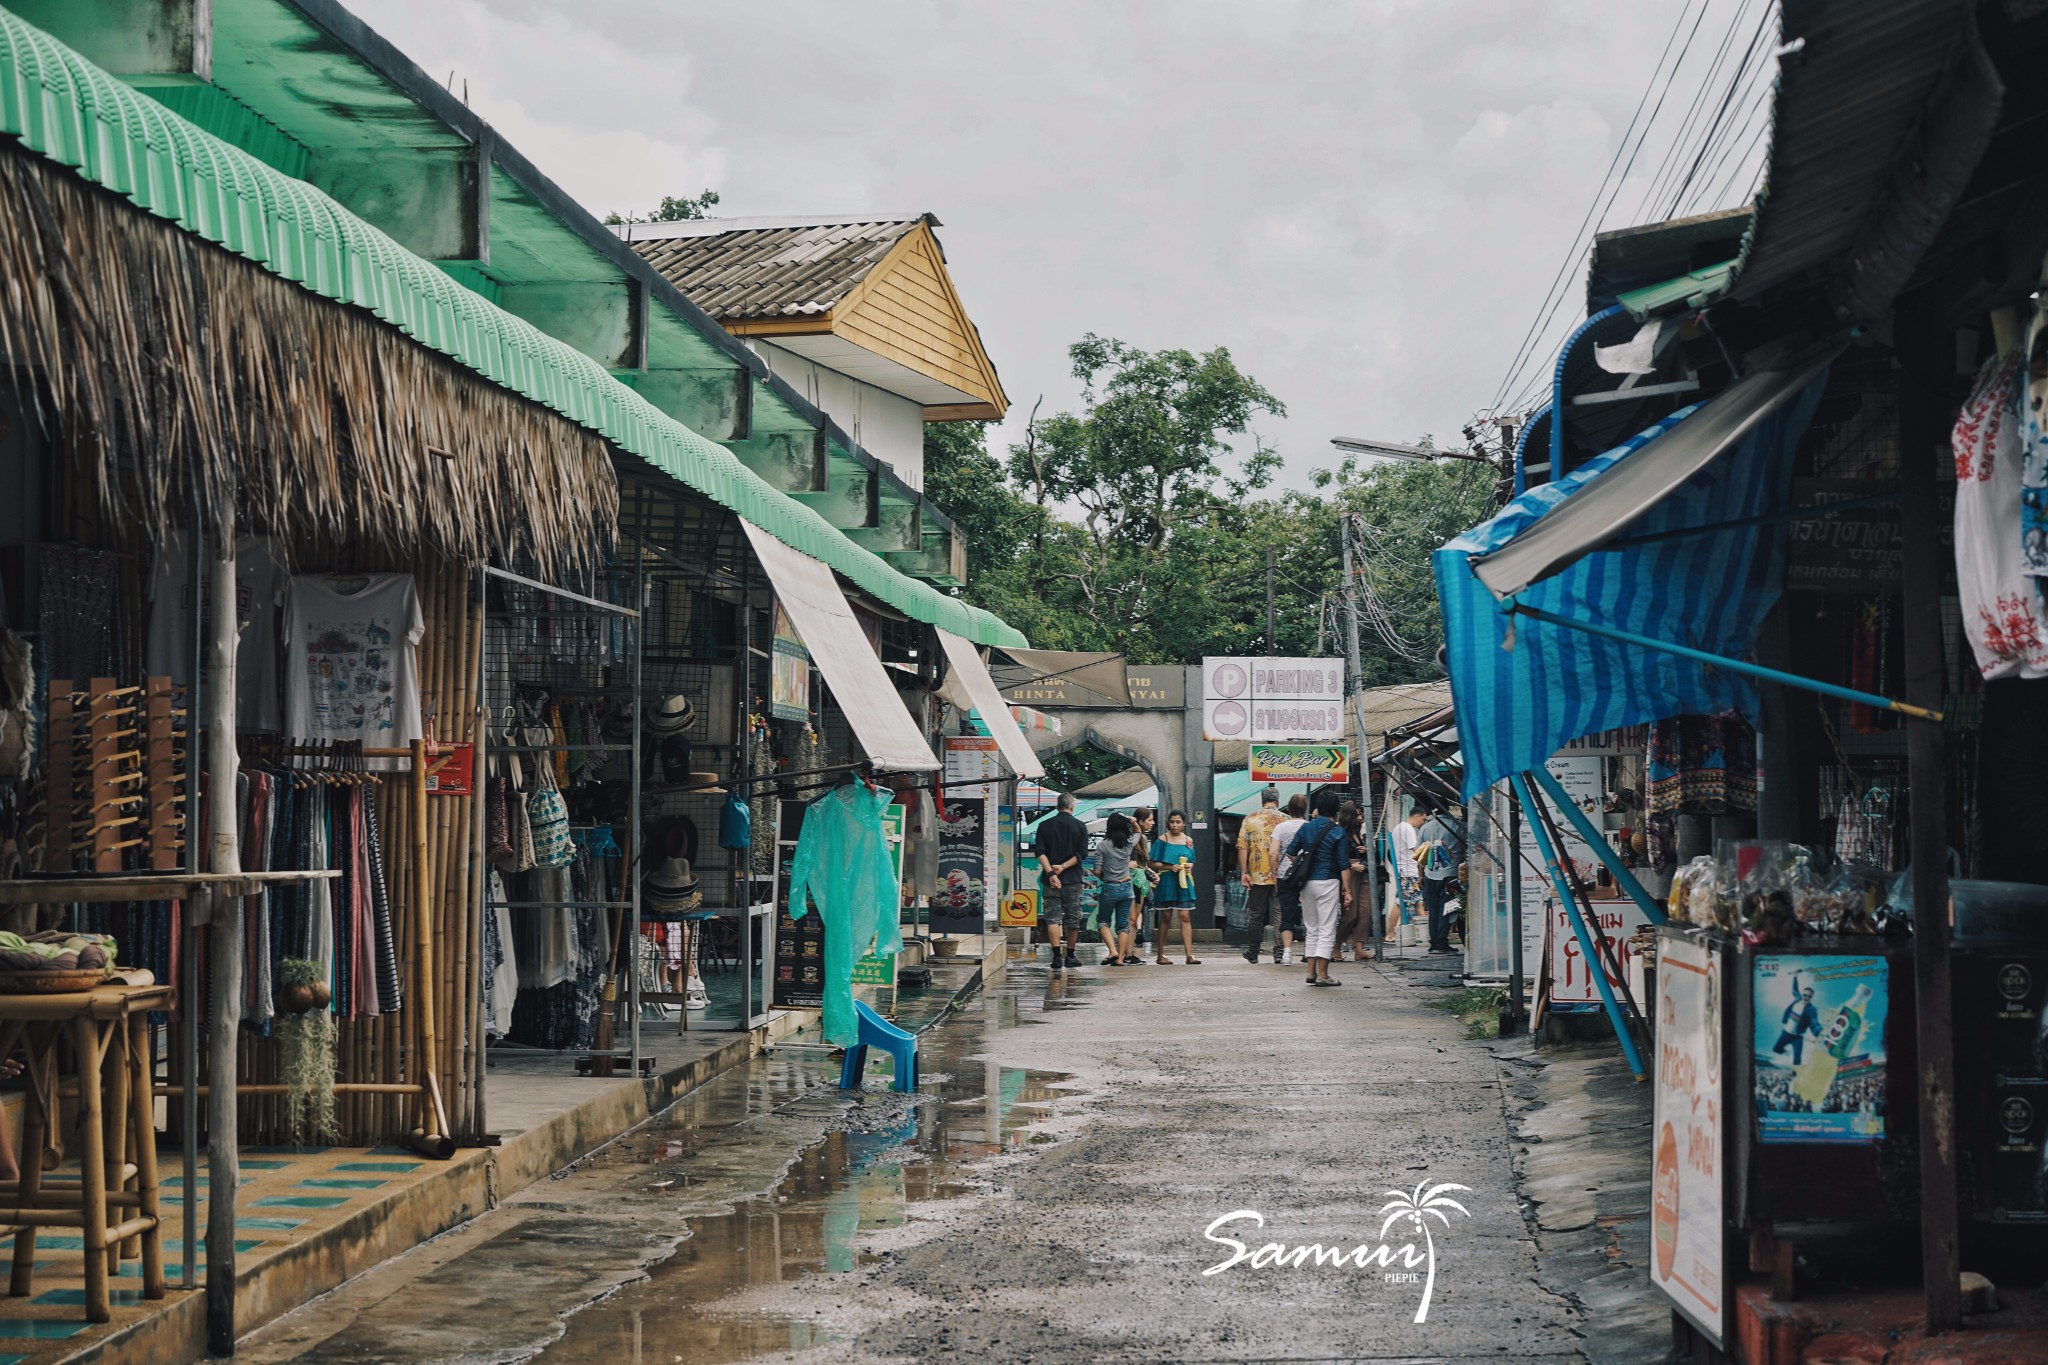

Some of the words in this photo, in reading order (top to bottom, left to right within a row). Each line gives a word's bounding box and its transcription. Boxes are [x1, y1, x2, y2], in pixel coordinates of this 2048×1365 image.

[1255, 669, 1324, 694] PARKING
[1328, 670, 1338, 694] 3
[1013, 690, 1066, 699] HINTA
[1129, 690, 1167, 699] NYAI
[1328, 707, 1338, 731] 3
[1256, 749, 1292, 769] Rock
[1292, 750, 1327, 769] Bar
